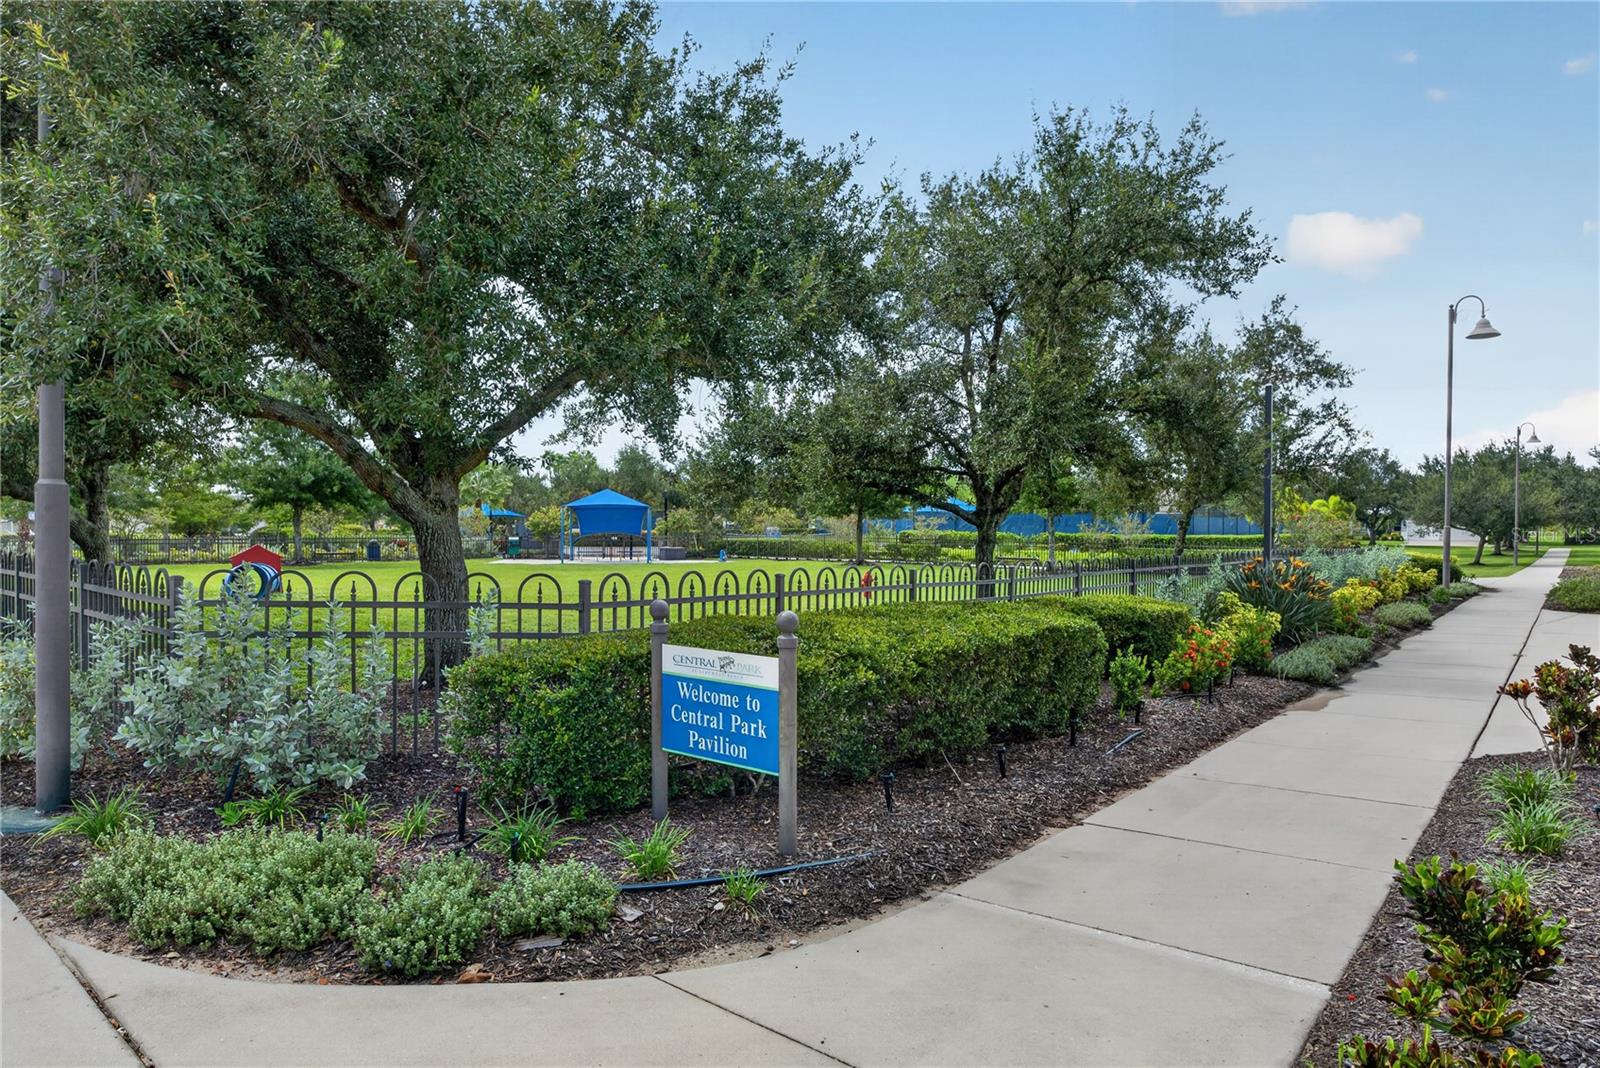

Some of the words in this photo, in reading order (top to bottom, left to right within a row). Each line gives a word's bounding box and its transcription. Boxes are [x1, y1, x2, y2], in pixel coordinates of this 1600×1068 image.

[672, 654, 717, 669] CENTRAL
[736, 662, 762, 675] PARK
[677, 680, 740, 709] Welcome
[745, 693, 760, 713] to
[671, 703, 724, 731] Central
[730, 713, 768, 739] Park
[687, 729, 748, 760] Pavilion
